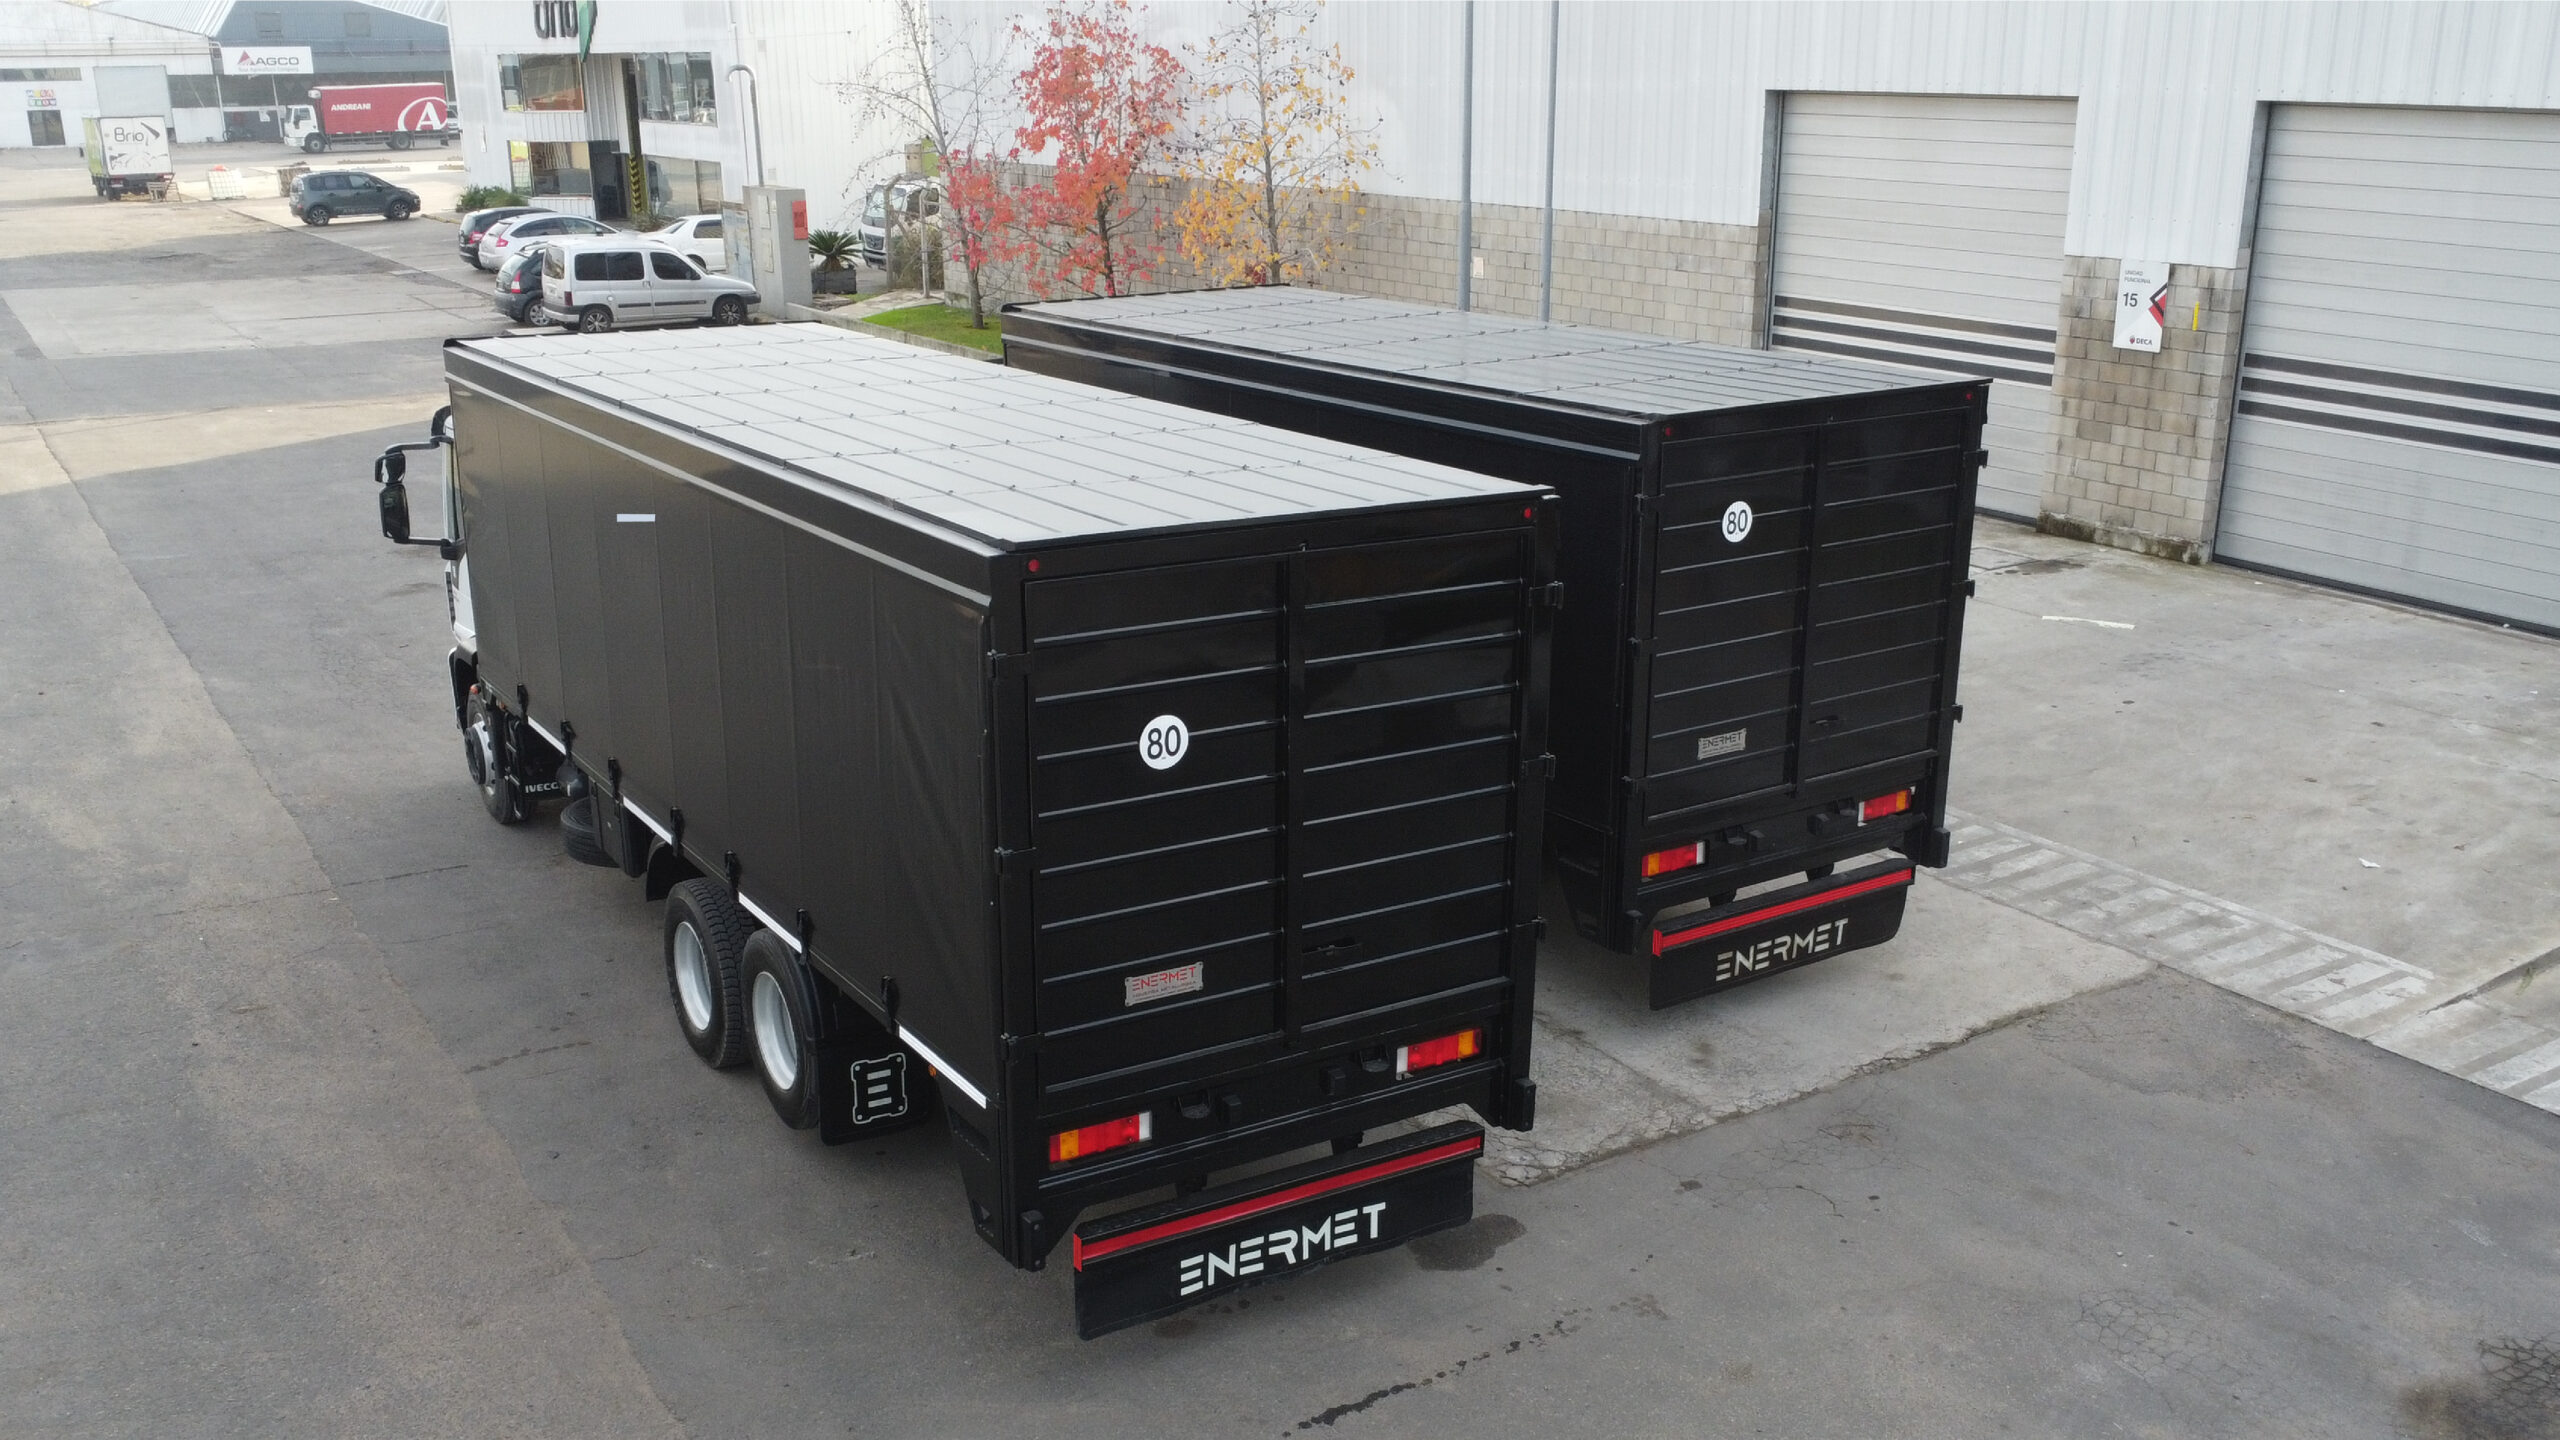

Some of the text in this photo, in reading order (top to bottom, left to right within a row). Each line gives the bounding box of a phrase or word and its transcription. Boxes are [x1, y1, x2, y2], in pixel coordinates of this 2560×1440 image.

[255, 57, 299, 66] AGCO
[330, 103, 372, 111] ANDREANI
[114, 127, 145, 142] Brio
[2123, 292, 2138, 307] 15
[2136, 337, 2153, 346] DECA
[1727, 509, 1748, 535] 80
[1147, 724, 1181, 760] 80
[1702, 732, 1743, 750] ENERMET
[1716, 917, 1849, 982] ENERMET
[1132, 966, 1197, 992] ENERMET
[1180, 1201, 1386, 1297] ENERMET
